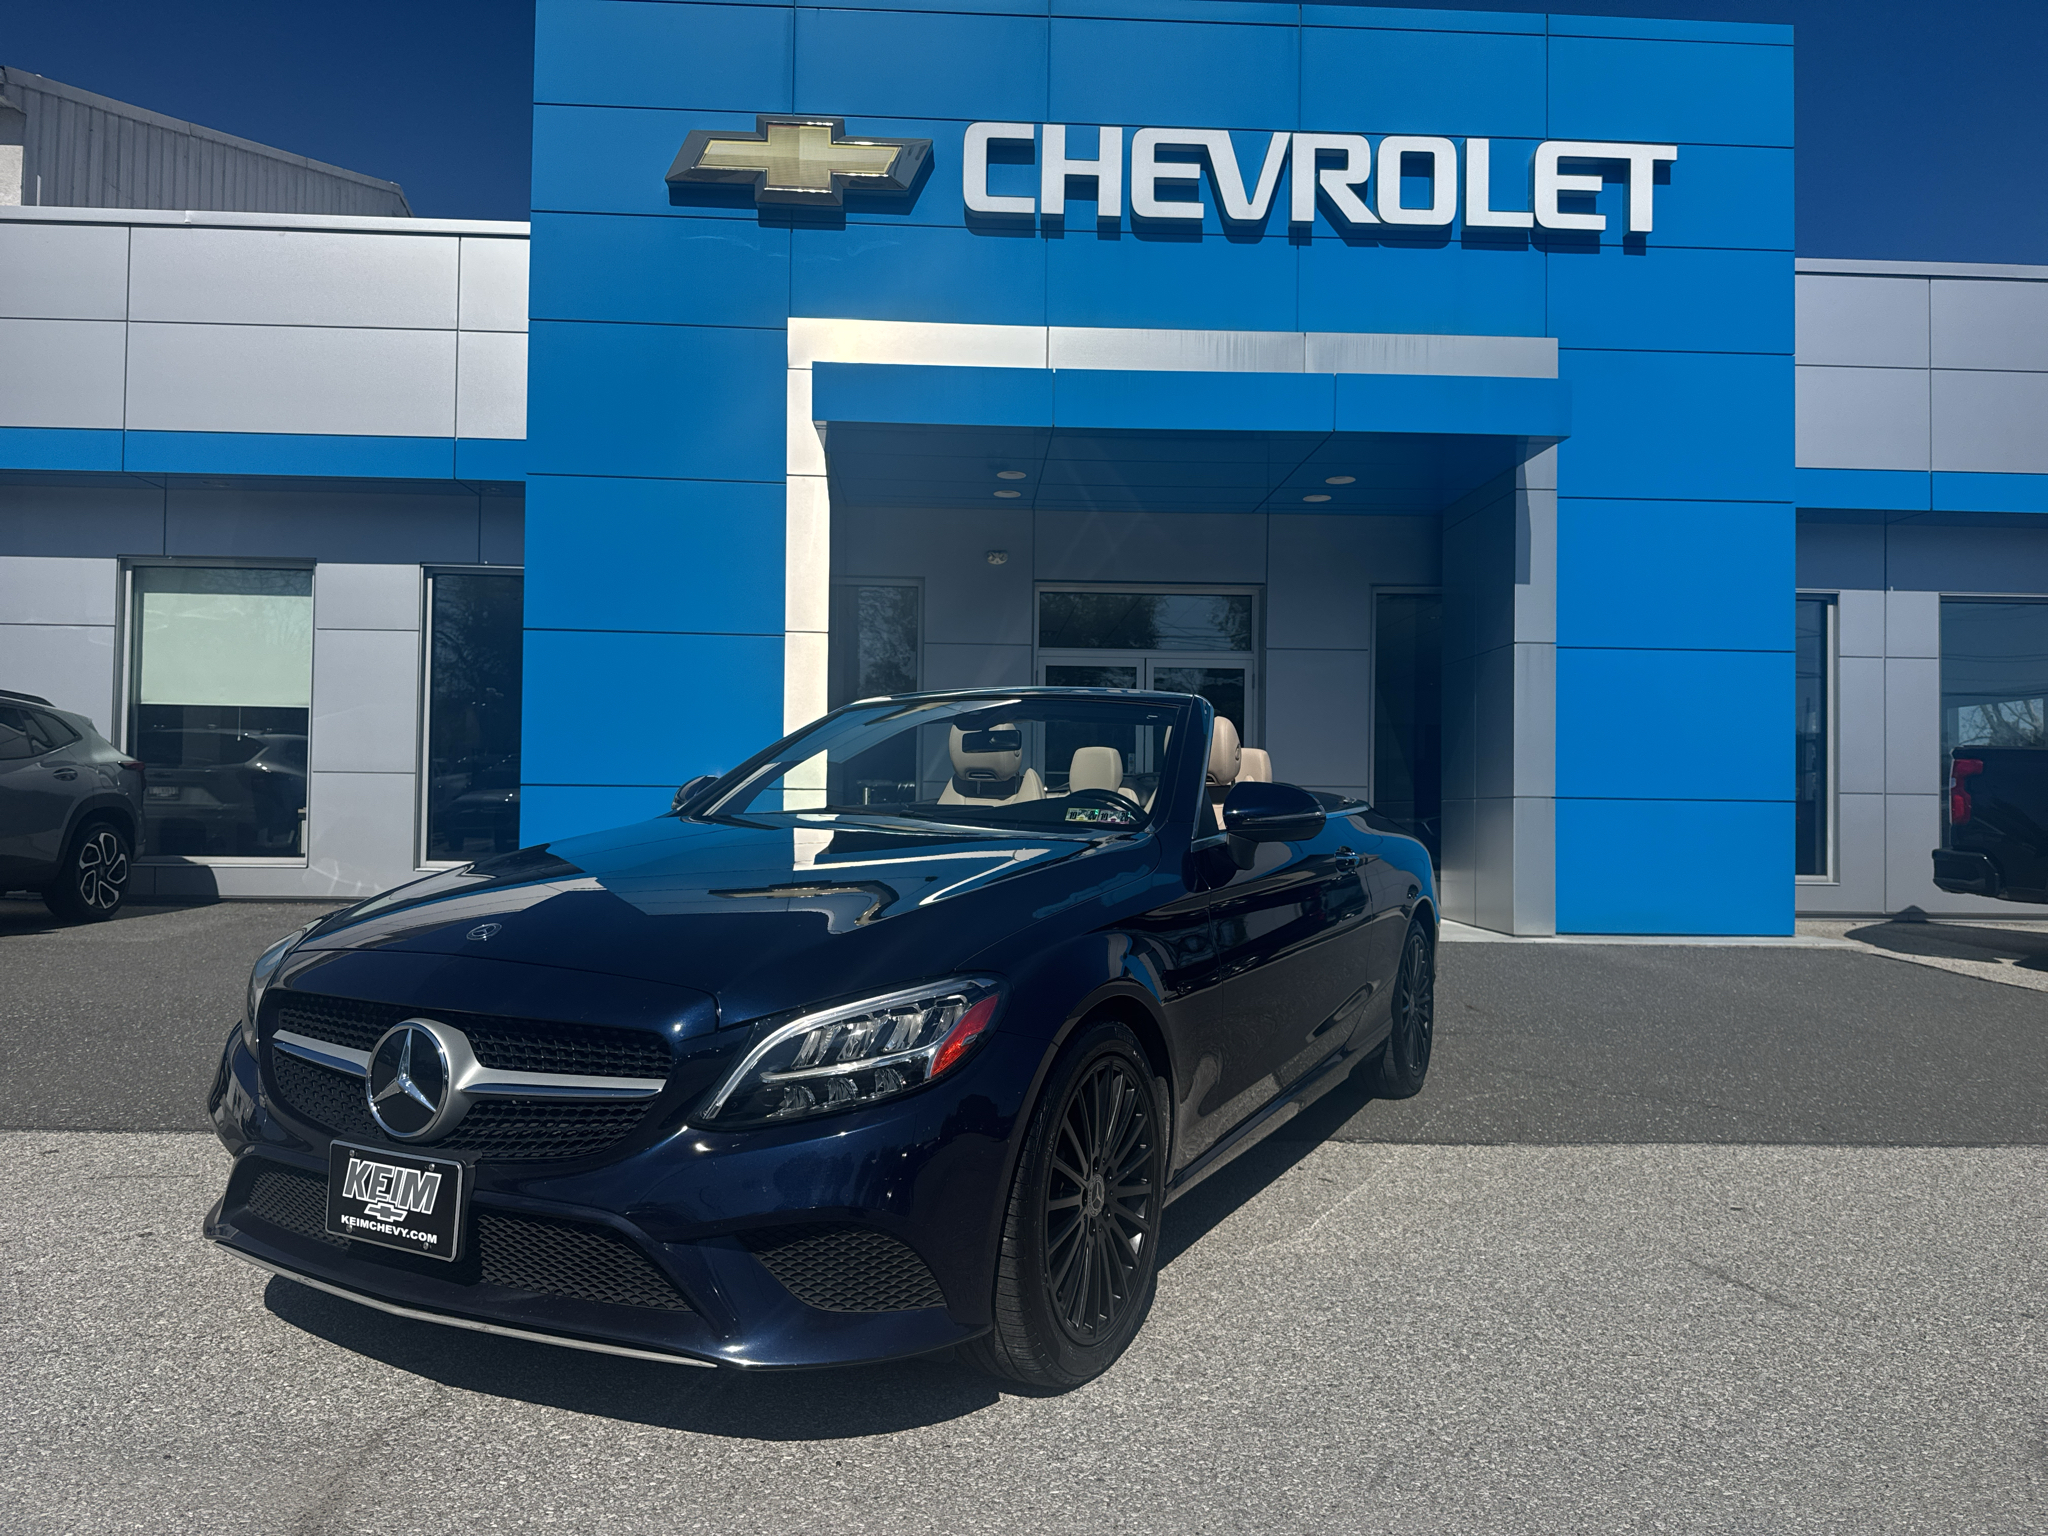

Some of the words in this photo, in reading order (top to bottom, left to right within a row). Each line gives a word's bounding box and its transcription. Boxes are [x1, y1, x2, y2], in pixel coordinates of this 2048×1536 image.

[963, 121, 1678, 234] CHEVROLET
[342, 1158, 442, 1215] KEIM
[341, 1215, 438, 1244] KEIMCHEVY.COM
